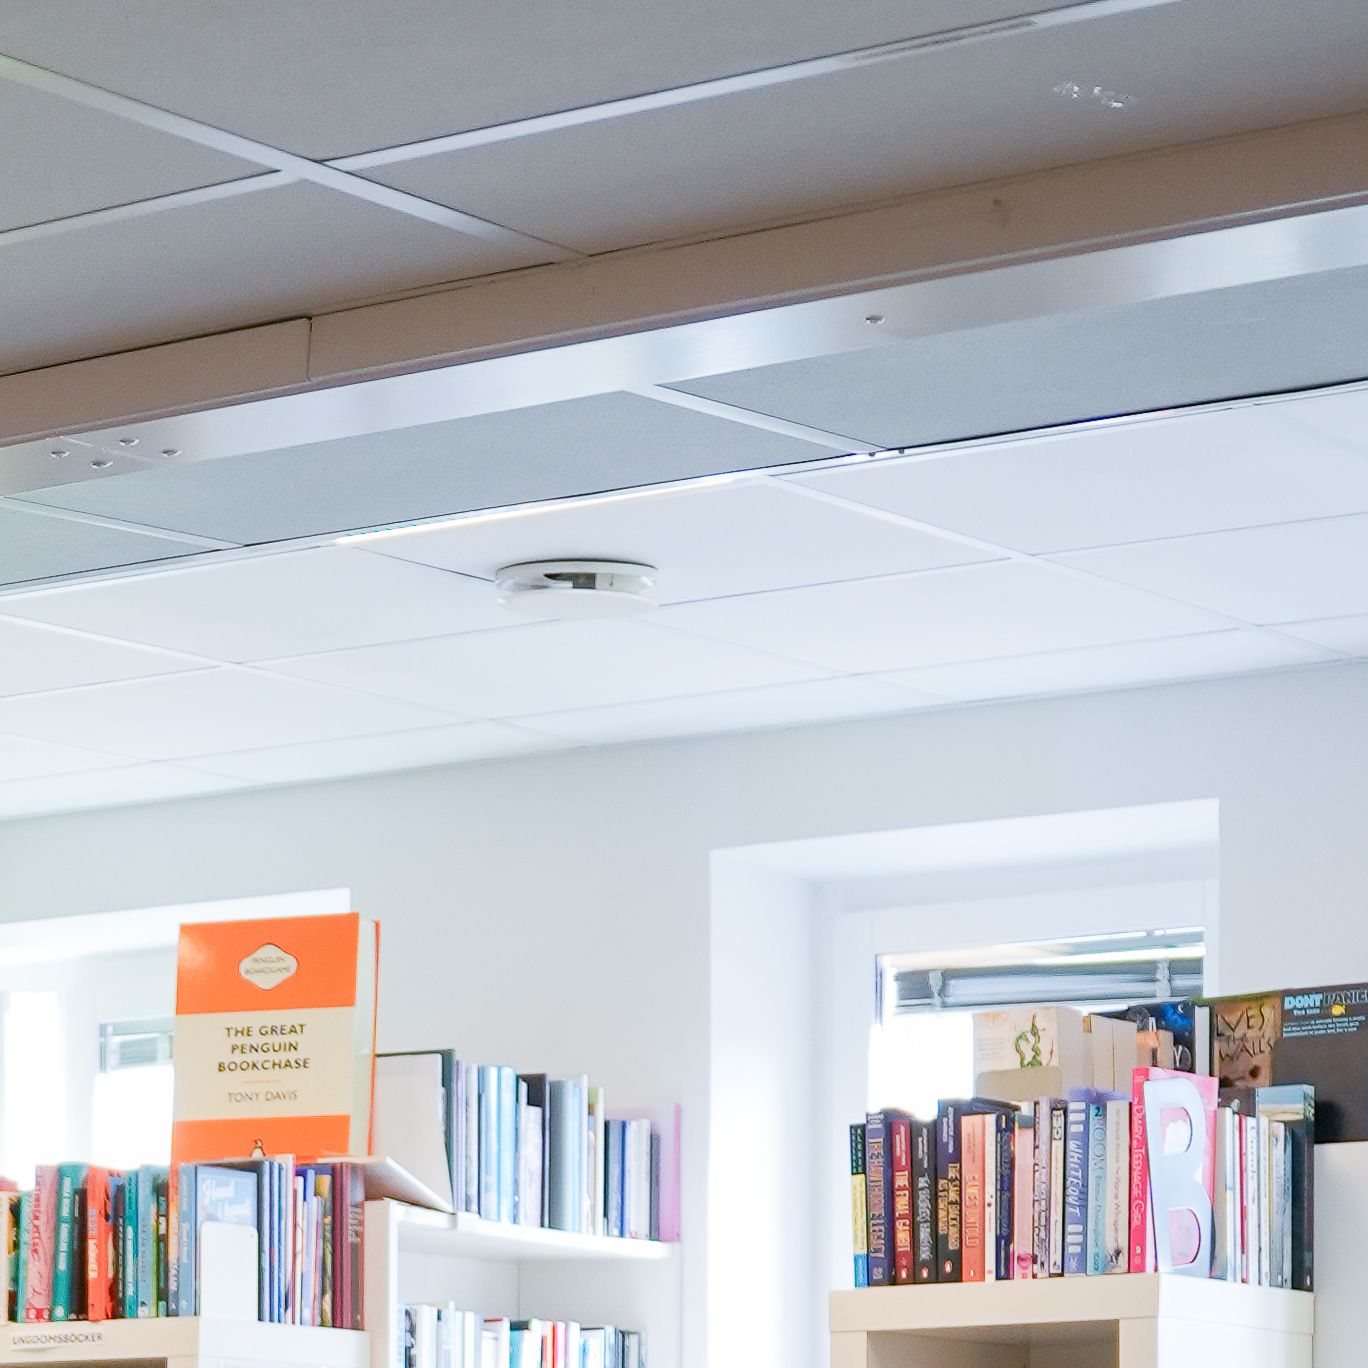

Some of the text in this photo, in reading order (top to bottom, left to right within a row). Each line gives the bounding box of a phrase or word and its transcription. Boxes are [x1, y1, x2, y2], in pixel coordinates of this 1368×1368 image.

[226, 1023, 306, 1038] THE GREAT
[231, 1042, 299, 1055] PENGUIN
[217, 1057, 311, 1072] BOOKCHASE
[227, 1089, 298, 1103] TONY DAVIS
[1065, 1139, 1083, 1217] WHITEOUT
